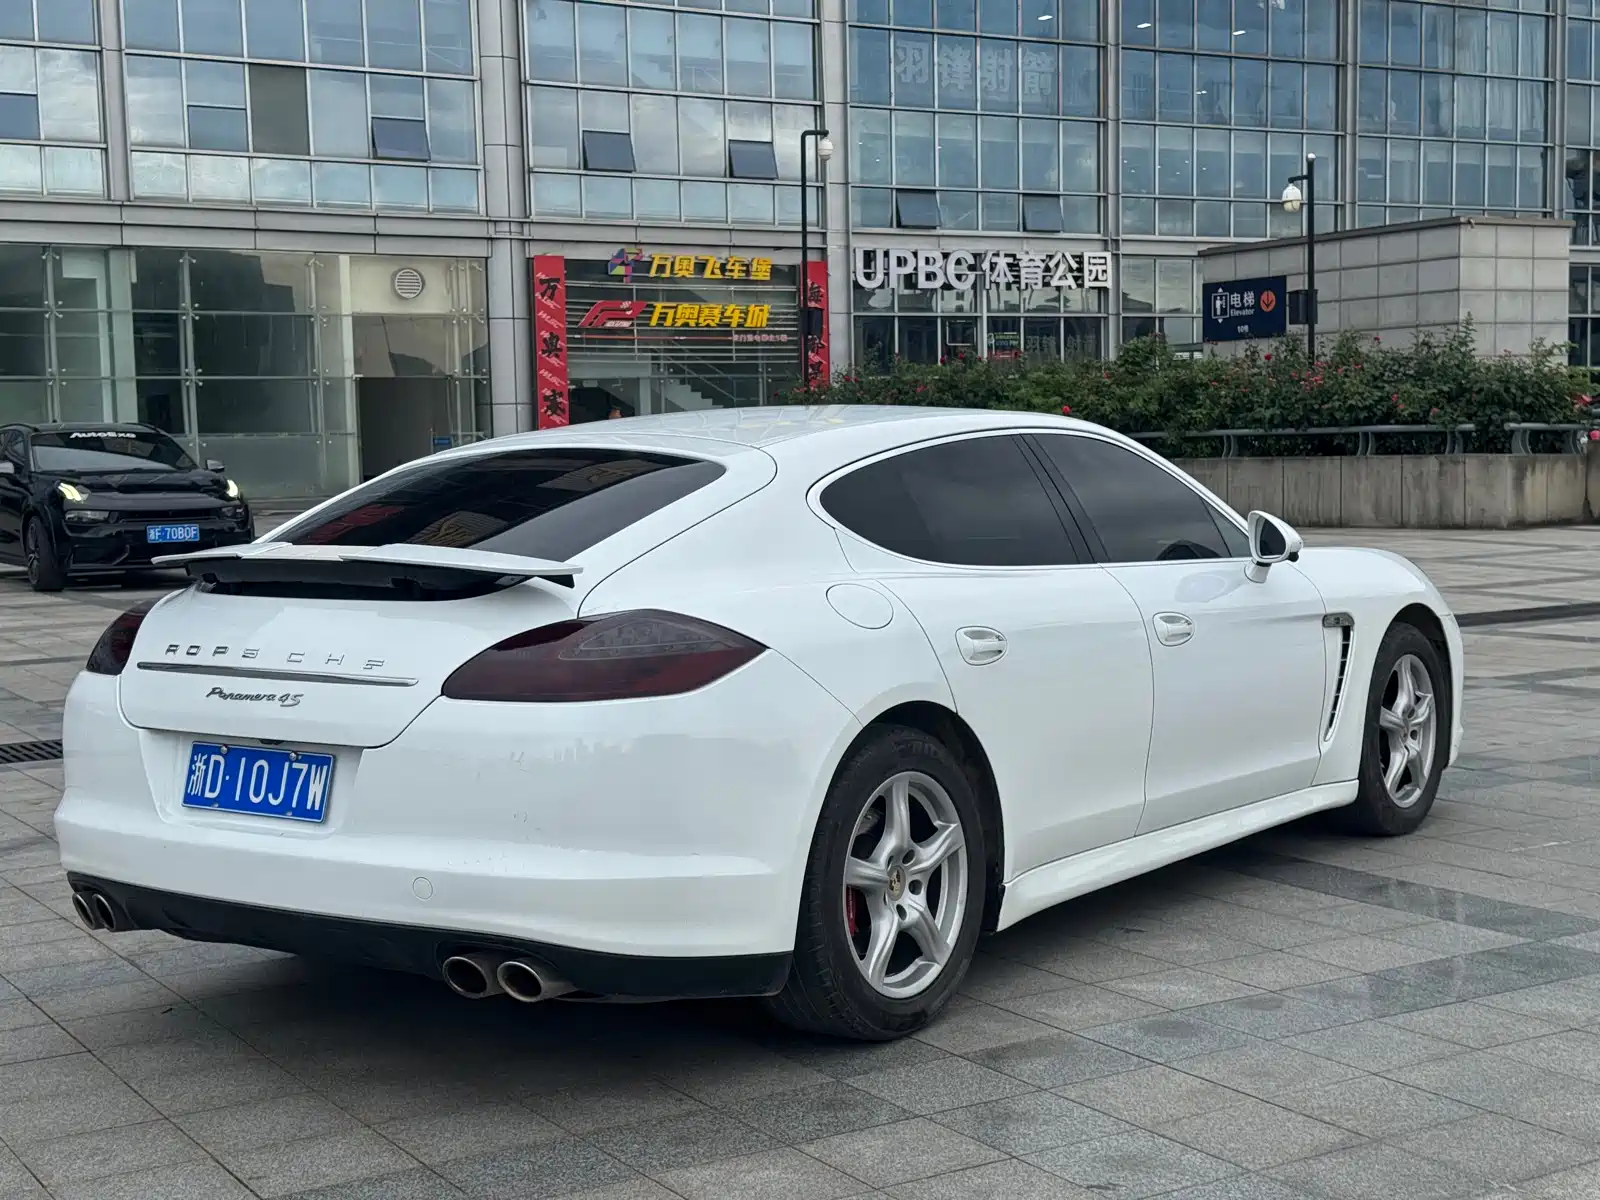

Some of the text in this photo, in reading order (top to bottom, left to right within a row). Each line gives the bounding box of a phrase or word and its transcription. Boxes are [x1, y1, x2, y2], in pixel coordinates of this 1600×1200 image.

[649, 254, 772, 280] 万奥飞车堡
[854, 248, 1112, 290] UPBC 体育公园
[1231, 290, 1255, 308] 电梯
[649, 303, 771, 328] 万奥赛车城
[1231, 308, 1255, 317] Elevator
[206, 687, 304, 707] Panamera 4S
